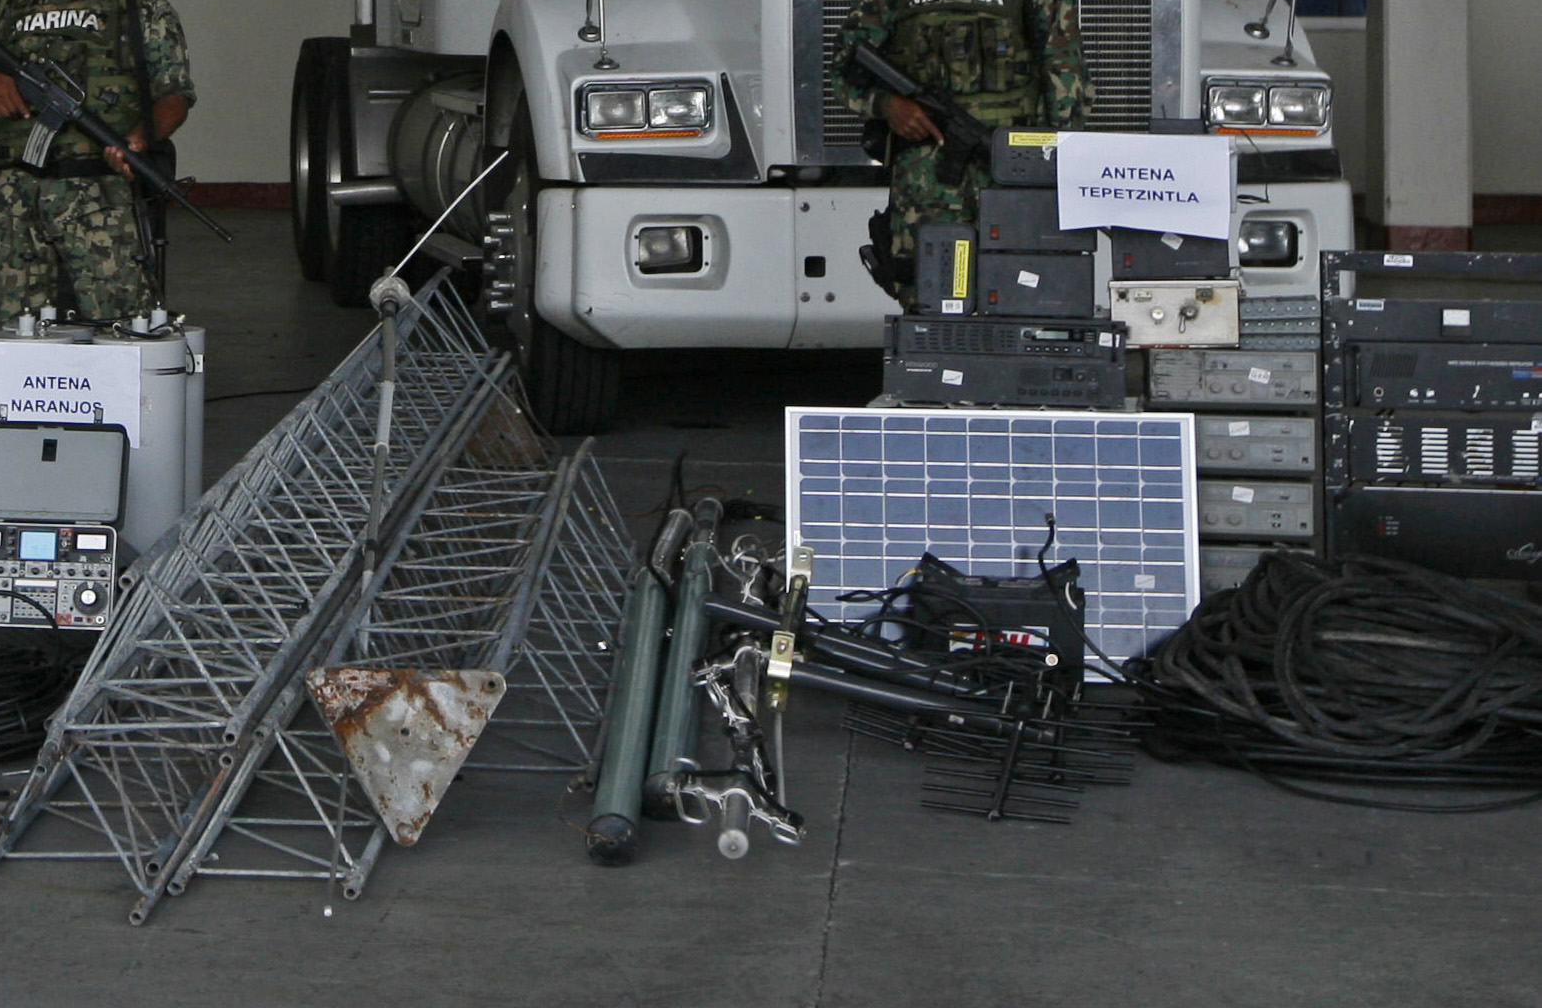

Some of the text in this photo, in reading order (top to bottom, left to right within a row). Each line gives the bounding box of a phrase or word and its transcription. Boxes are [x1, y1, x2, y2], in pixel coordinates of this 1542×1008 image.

[1101, 166, 1175, 181] ANTENA
[1078, 186, 1200, 203] TEPETZINTLA
[22, 376, 91, 391] ANTENA
